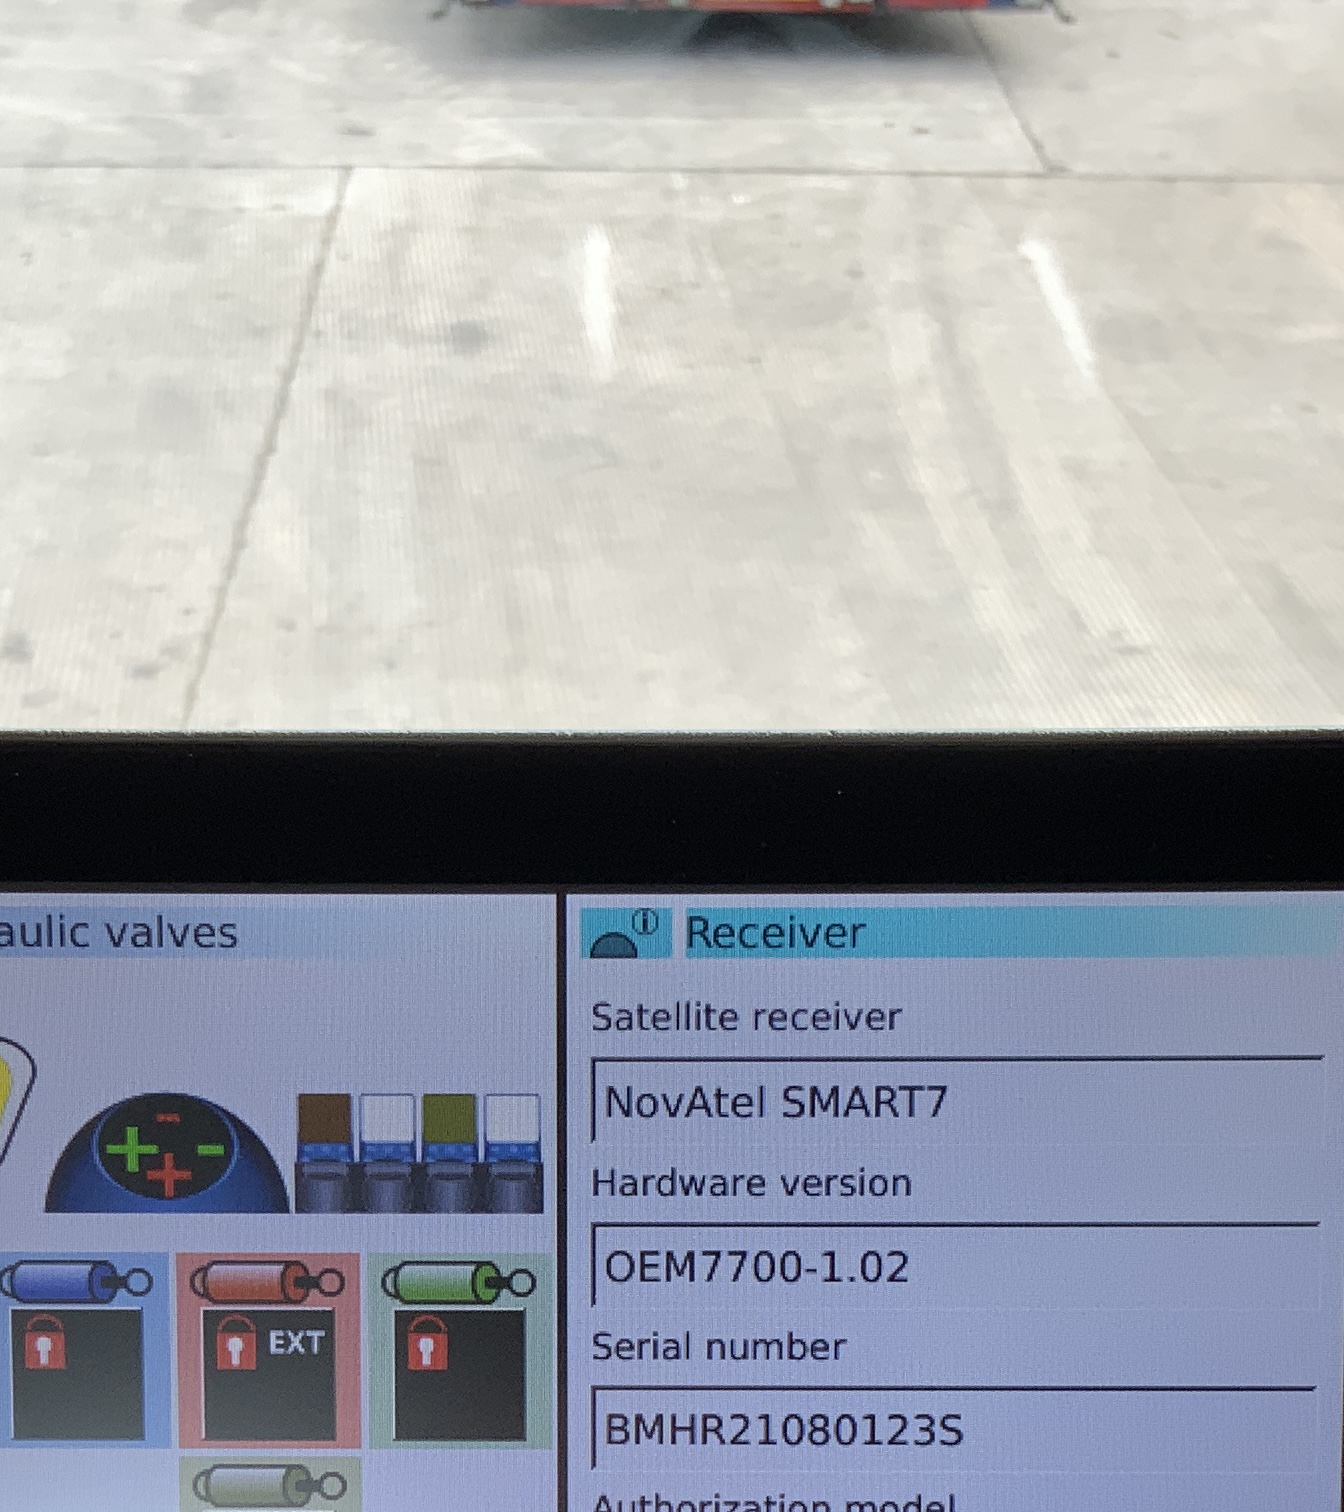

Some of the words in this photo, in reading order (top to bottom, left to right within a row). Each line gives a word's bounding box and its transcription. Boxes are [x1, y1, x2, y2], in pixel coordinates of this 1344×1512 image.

[104, 915, 238, 948] valves
[687, 916, 867, 949] Receiver
[592, 1001, 739, 1031] Satellite
[754, 1001, 903, 1031] receiver
[605, 1085, 766, 1118] NovAtel
[782, 1085, 948, 1118] SMART7
[592, 1168, 766, 1197] Hardware
[781, 1168, 912, 1197] version
[605, 1250, 909, 1283] OEM7700-1.02
[269, 1330, 325, 1354] EXT
[592, 1331, 690, 1361] Serial
[706, 1332, 848, 1361] number
[606, 1413, 964, 1446] BMHR21080123S
